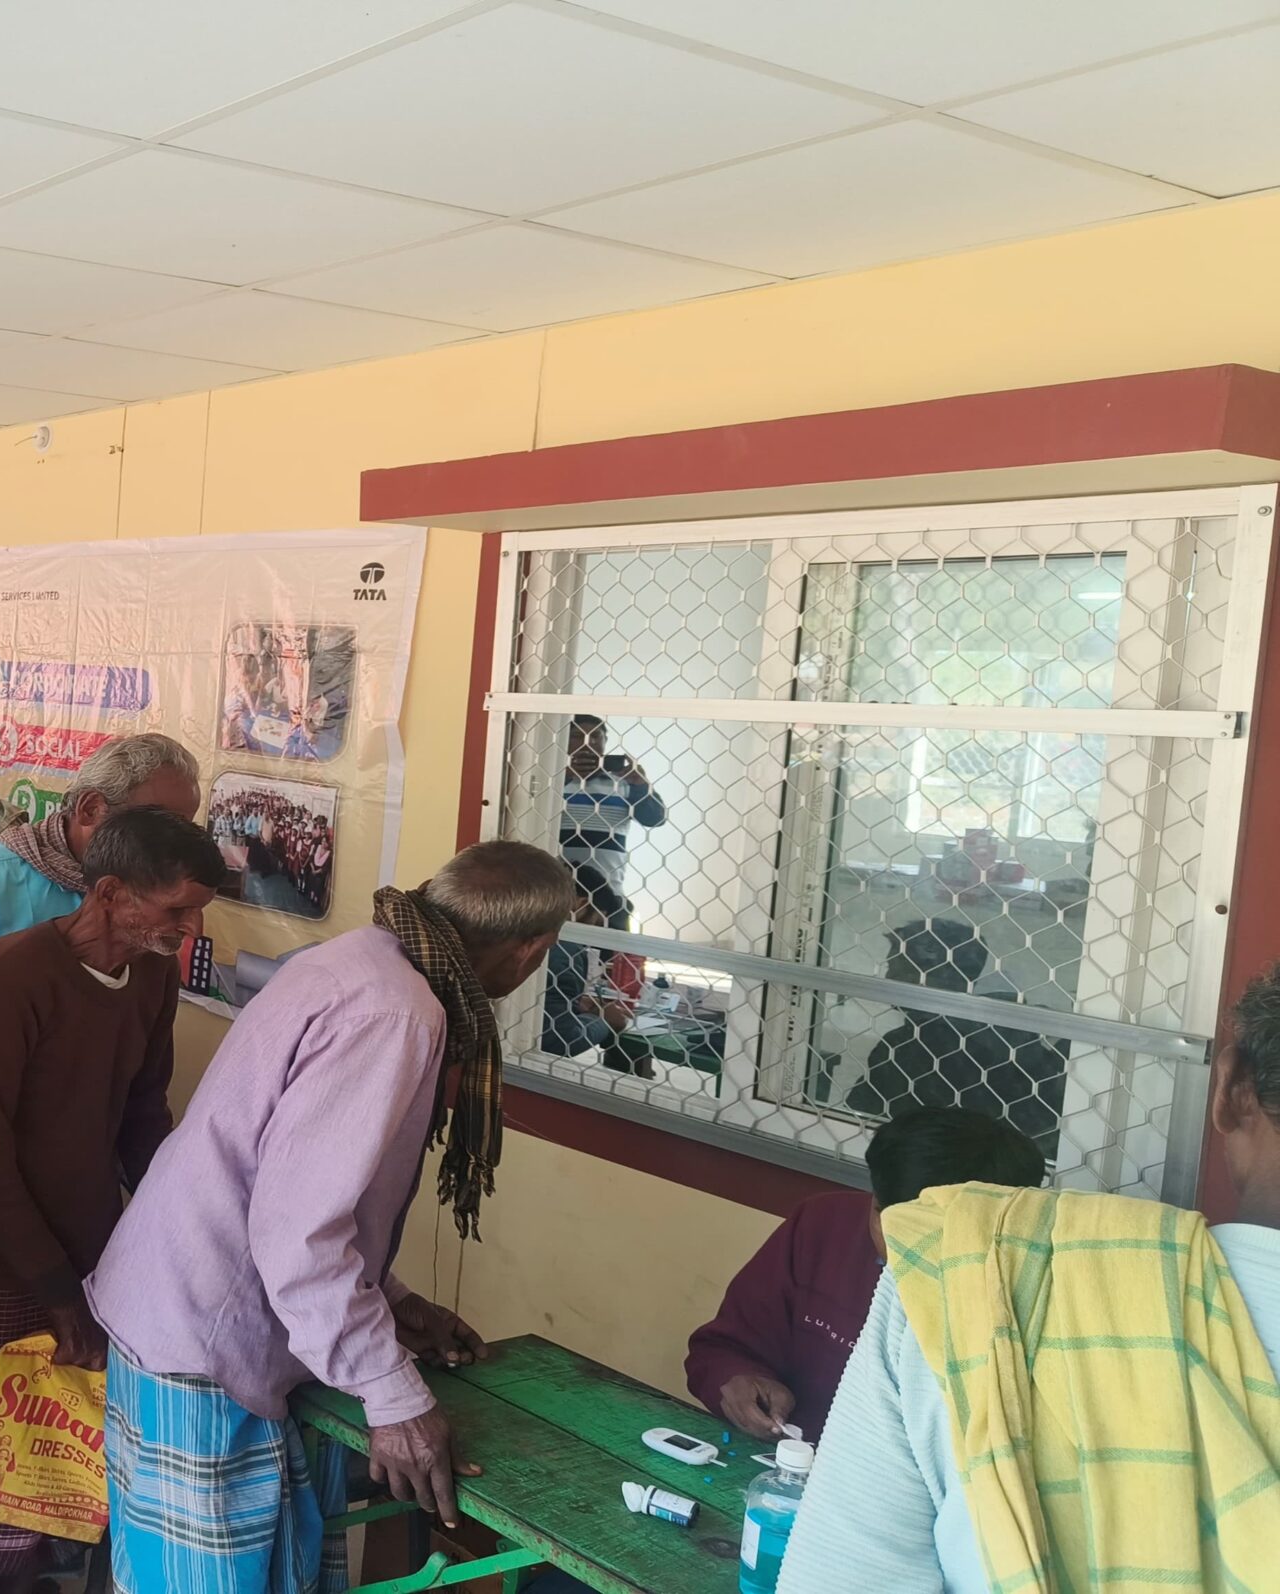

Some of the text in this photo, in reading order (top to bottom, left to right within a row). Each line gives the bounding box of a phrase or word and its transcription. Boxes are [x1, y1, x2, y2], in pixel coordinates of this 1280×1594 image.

[353, 588, 387, 601] TATA
[26, 734, 82, 761] SOCIAL
[29, 1438, 106, 1479] DRESSES
[0, 1493, 20, 1507] MAIN
[20, 1499, 43, 1515] ROAD,
[43, 1504, 94, 1520] HALDIPOKHAR
